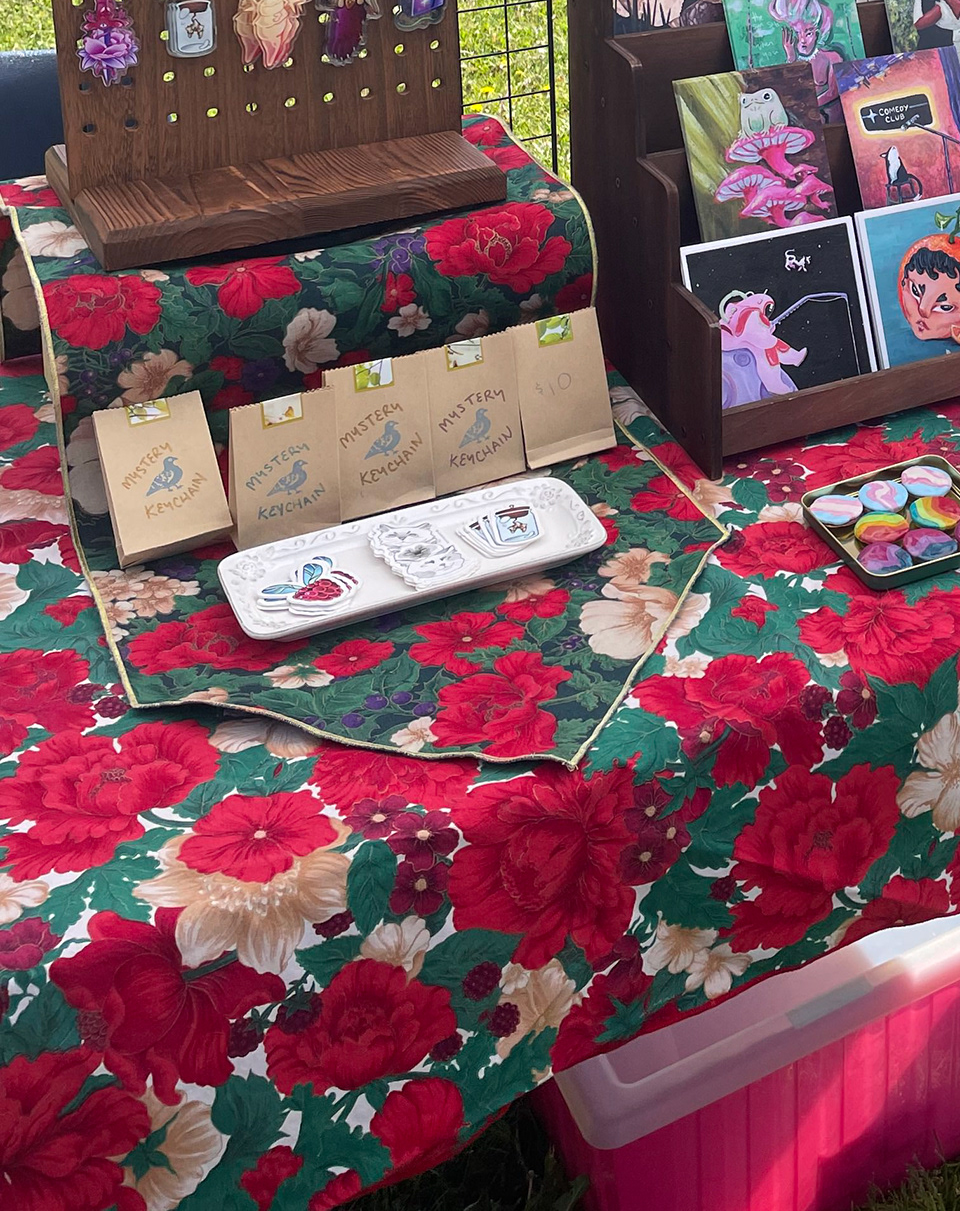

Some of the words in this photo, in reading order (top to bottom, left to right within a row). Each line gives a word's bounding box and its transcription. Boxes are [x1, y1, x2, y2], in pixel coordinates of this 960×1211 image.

[878, 104, 909, 116] COMEDY
[885, 113, 906, 123] CLUB
[535, 372, 572, 396] $10
[340, 402, 403, 449] MYSTERY
[439, 389, 506, 433] MYSTERY
[122, 442, 173, 490] MYSTERY
[246, 442, 310, 491] MYSTERY
[360, 432, 424, 486] KEYCHAIN
[450, 425, 513, 468] KEYCHAIN
[144, 472, 208, 519] KEYCHAIN
[257, 483, 326, 520] KEYCHAIN
